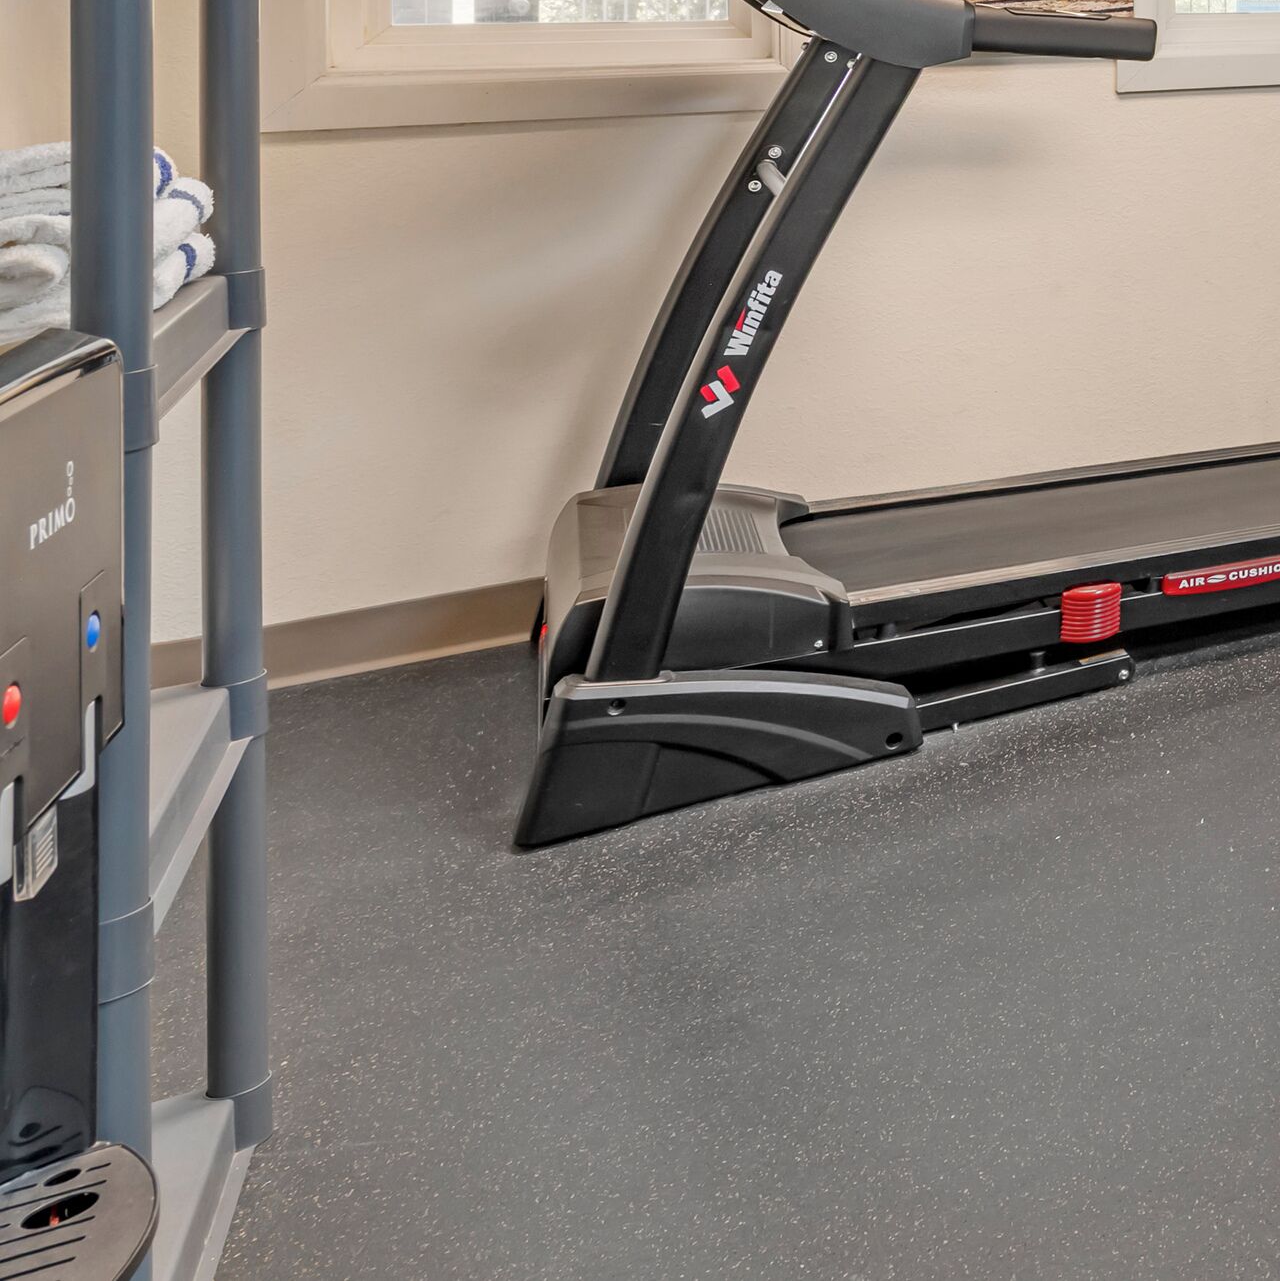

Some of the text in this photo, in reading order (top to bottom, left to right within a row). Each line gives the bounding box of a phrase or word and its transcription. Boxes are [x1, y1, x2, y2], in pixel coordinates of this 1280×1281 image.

[724, 270, 783, 356] Winfita
[29, 497, 76, 551] PRIMO
[1179, 577, 1206, 589] AIR
